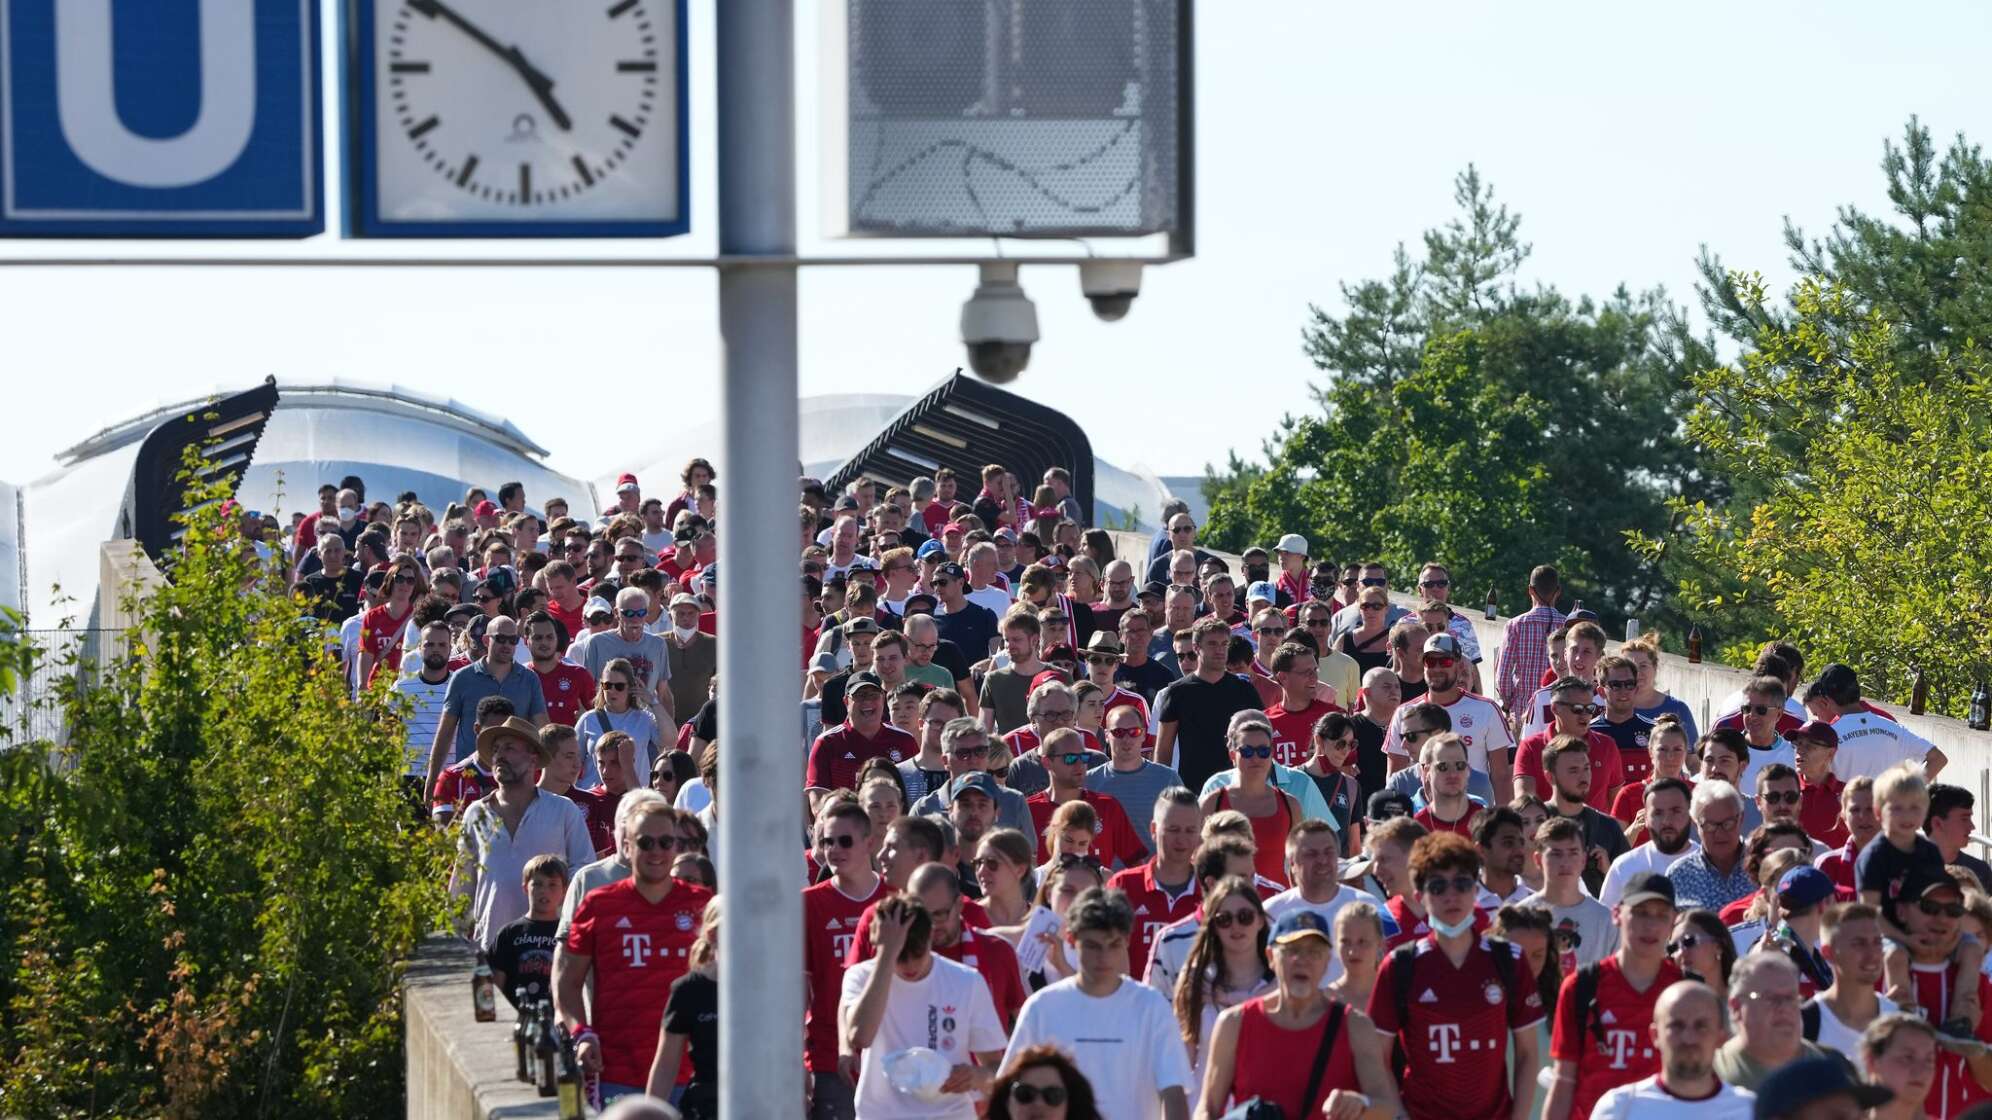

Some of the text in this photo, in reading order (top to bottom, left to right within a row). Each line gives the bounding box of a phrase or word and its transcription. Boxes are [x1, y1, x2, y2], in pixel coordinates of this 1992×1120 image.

[56, 0, 257, 188] U
[1842, 728, 1869, 741] BAYERN
[1276, 741, 1296, 766] T
[513, 933, 558, 948] CHAMPIO
[623, 934, 651, 967] T
[1428, 1023, 1460, 1063] T
[1607, 1030, 1637, 1069] T
